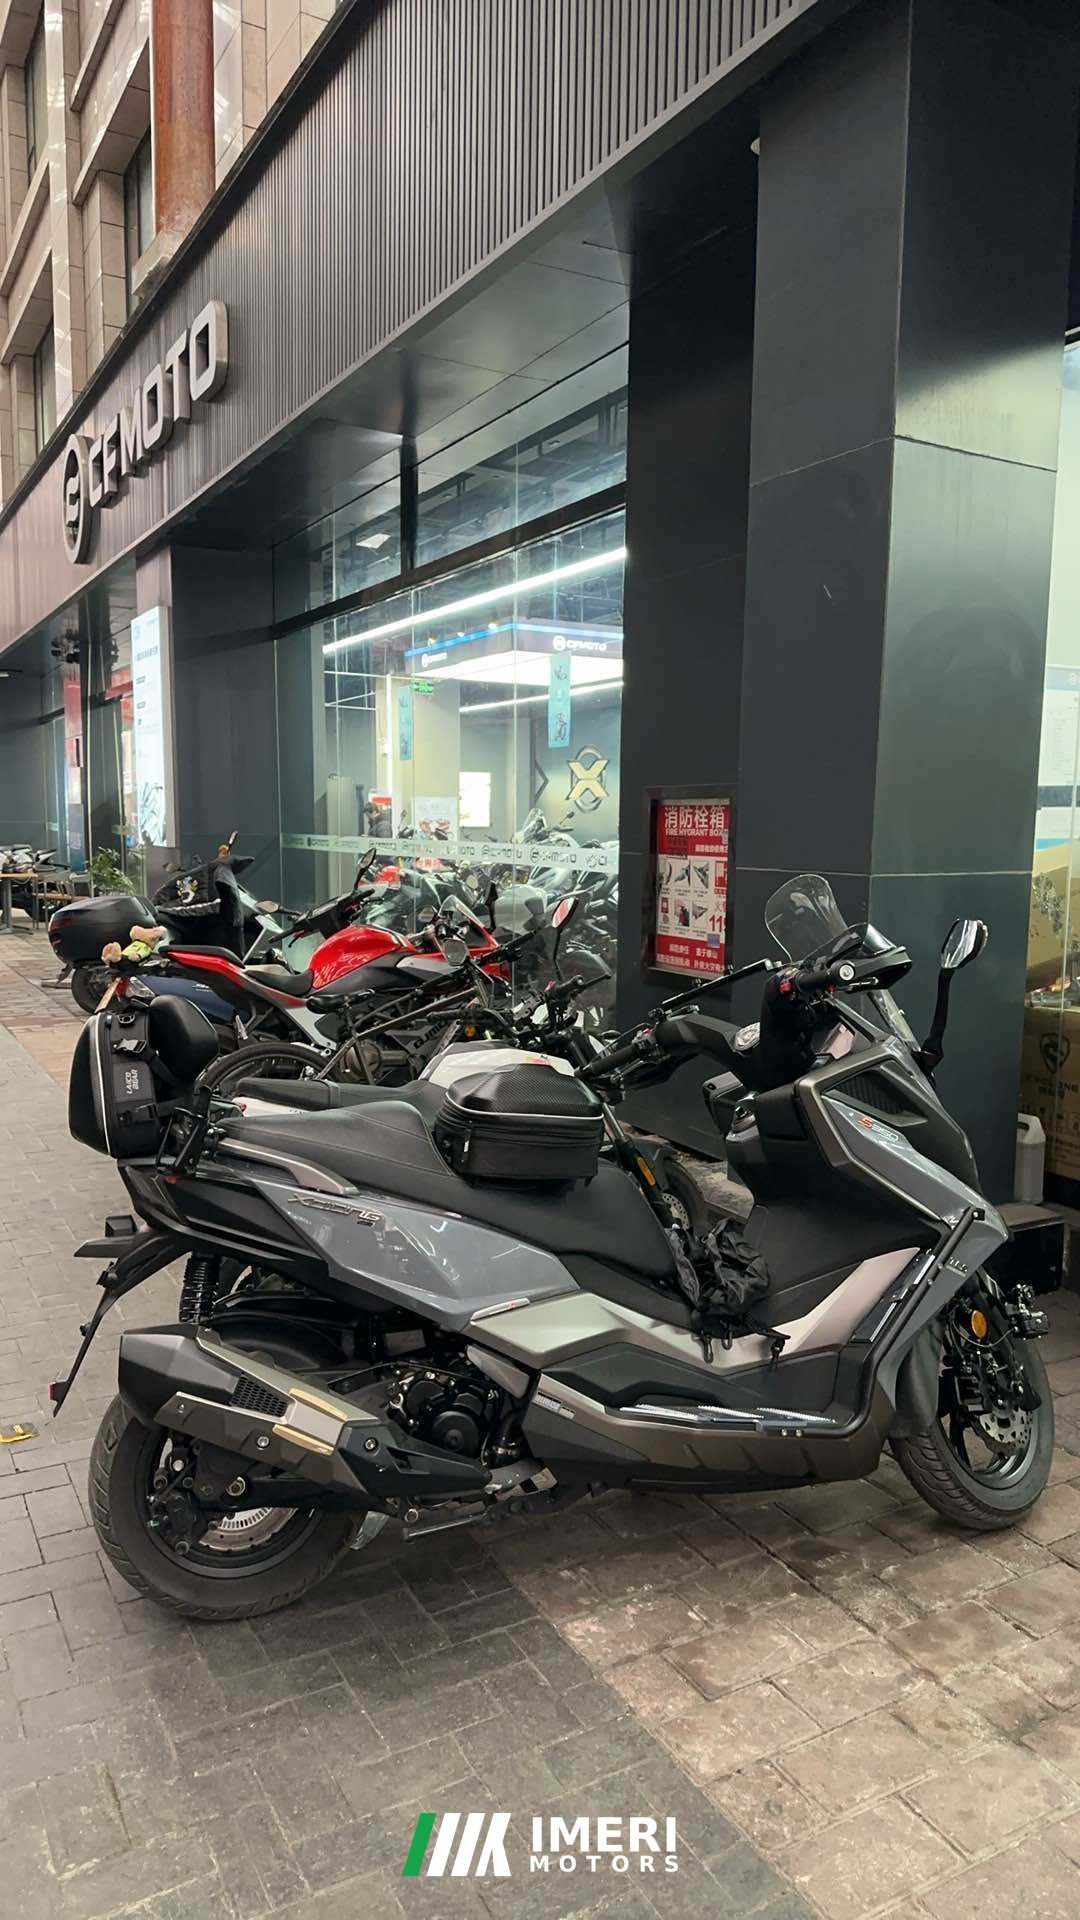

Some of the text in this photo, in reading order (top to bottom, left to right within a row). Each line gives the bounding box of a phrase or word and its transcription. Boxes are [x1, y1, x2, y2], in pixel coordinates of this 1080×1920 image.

[88, 301, 228, 508] CFMOTO
[664, 806, 725, 829] 消防栓箱
